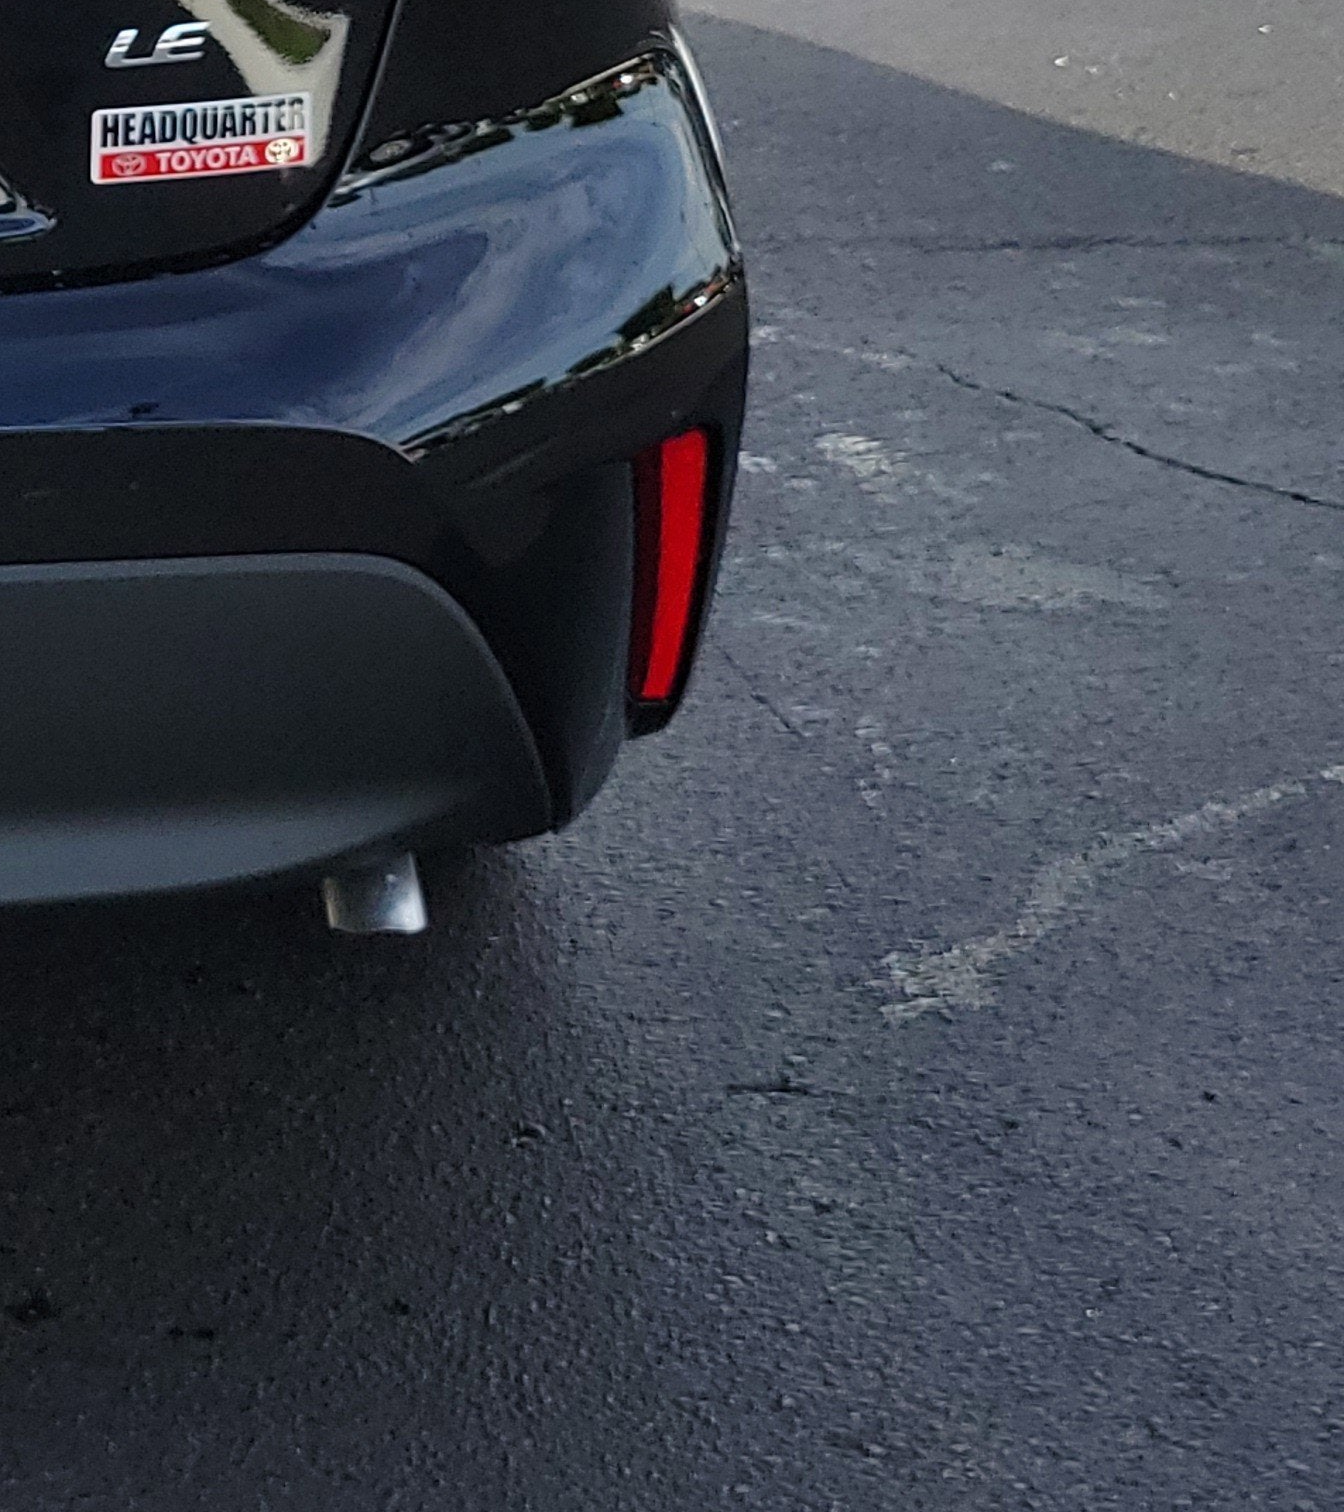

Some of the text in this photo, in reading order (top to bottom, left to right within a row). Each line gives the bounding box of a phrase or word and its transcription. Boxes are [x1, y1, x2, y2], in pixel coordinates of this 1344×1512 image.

[104, 20, 211, 68] LE
[100, 96, 306, 148] HEADQUARTER
[154, 144, 260, 174] TOYOTA
